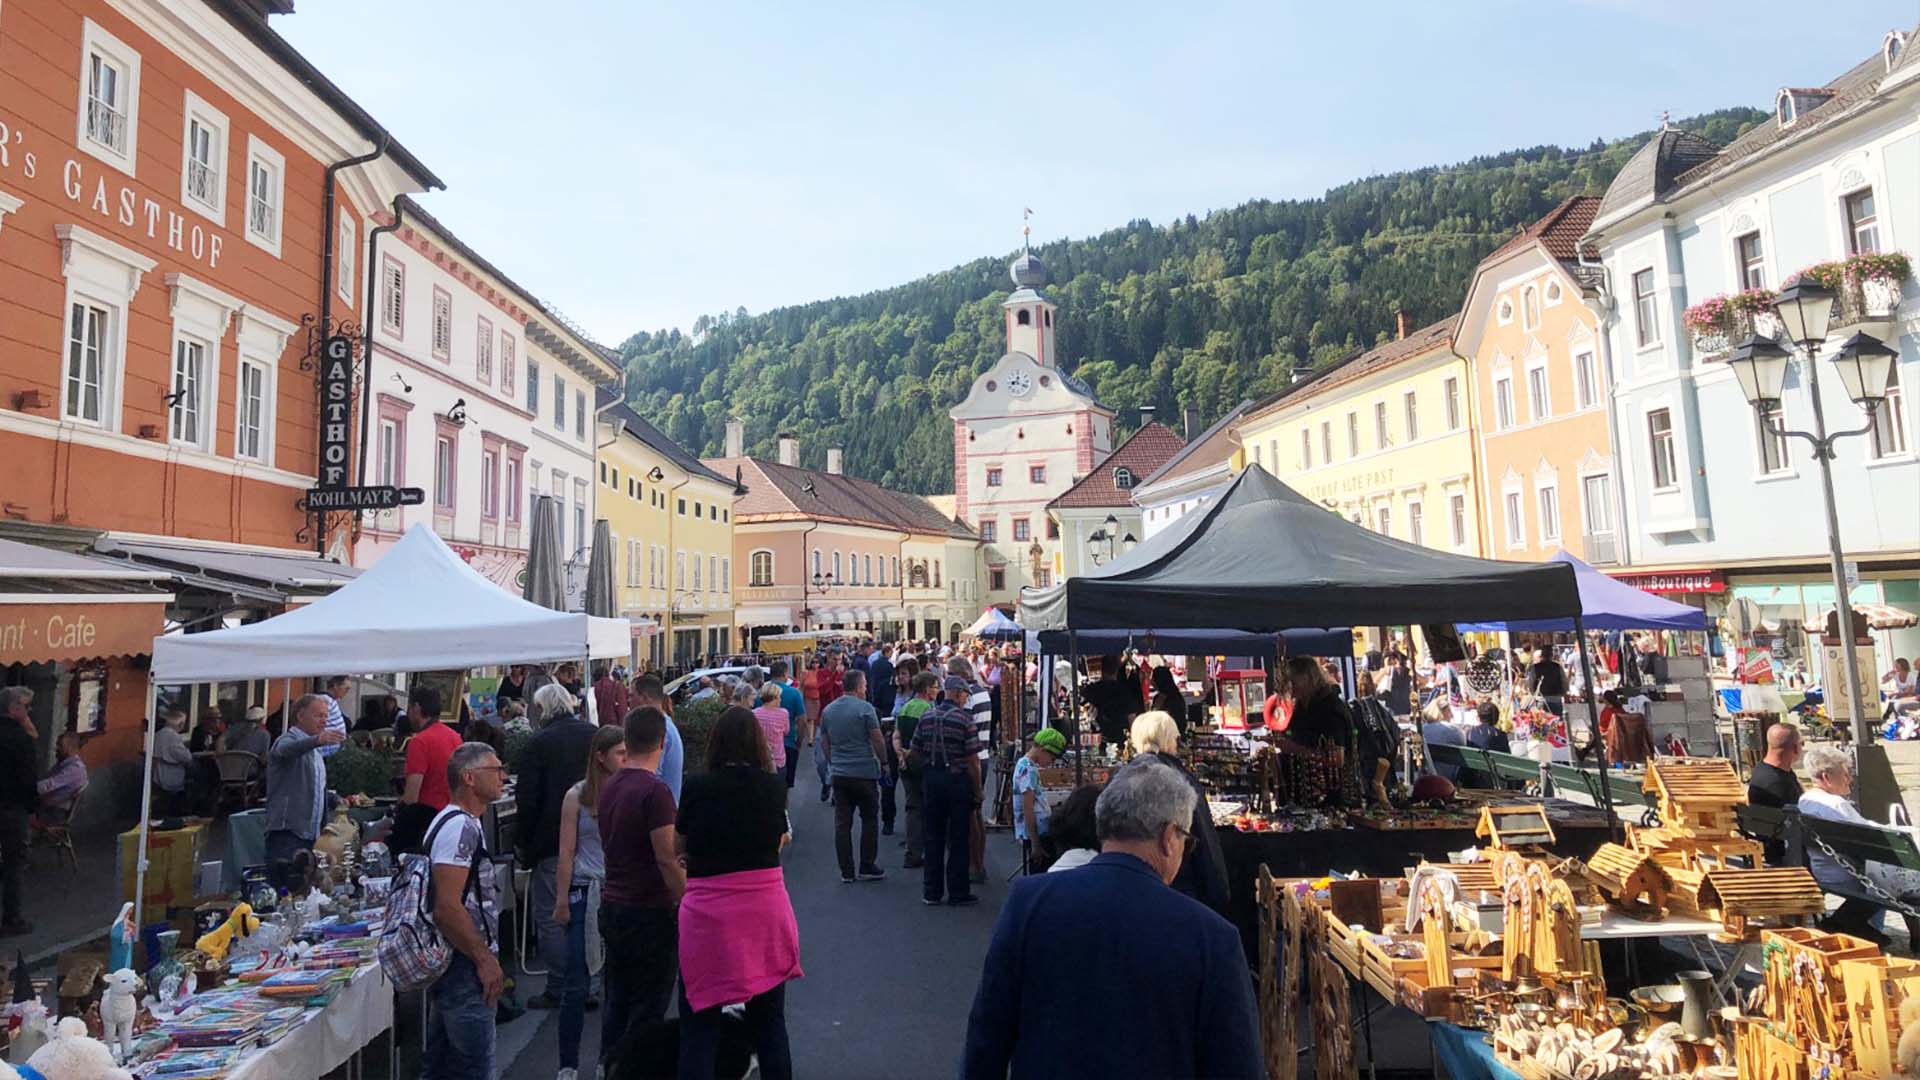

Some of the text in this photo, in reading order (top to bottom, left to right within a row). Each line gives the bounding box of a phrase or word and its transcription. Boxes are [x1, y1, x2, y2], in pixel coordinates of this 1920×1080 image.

[63, 159, 223, 268] GASTHOF
[326, 340, 347, 485] GASTHOF
[309, 489, 394, 507] KOHLMAYR
[46, 614, 96, 649] Cafe
